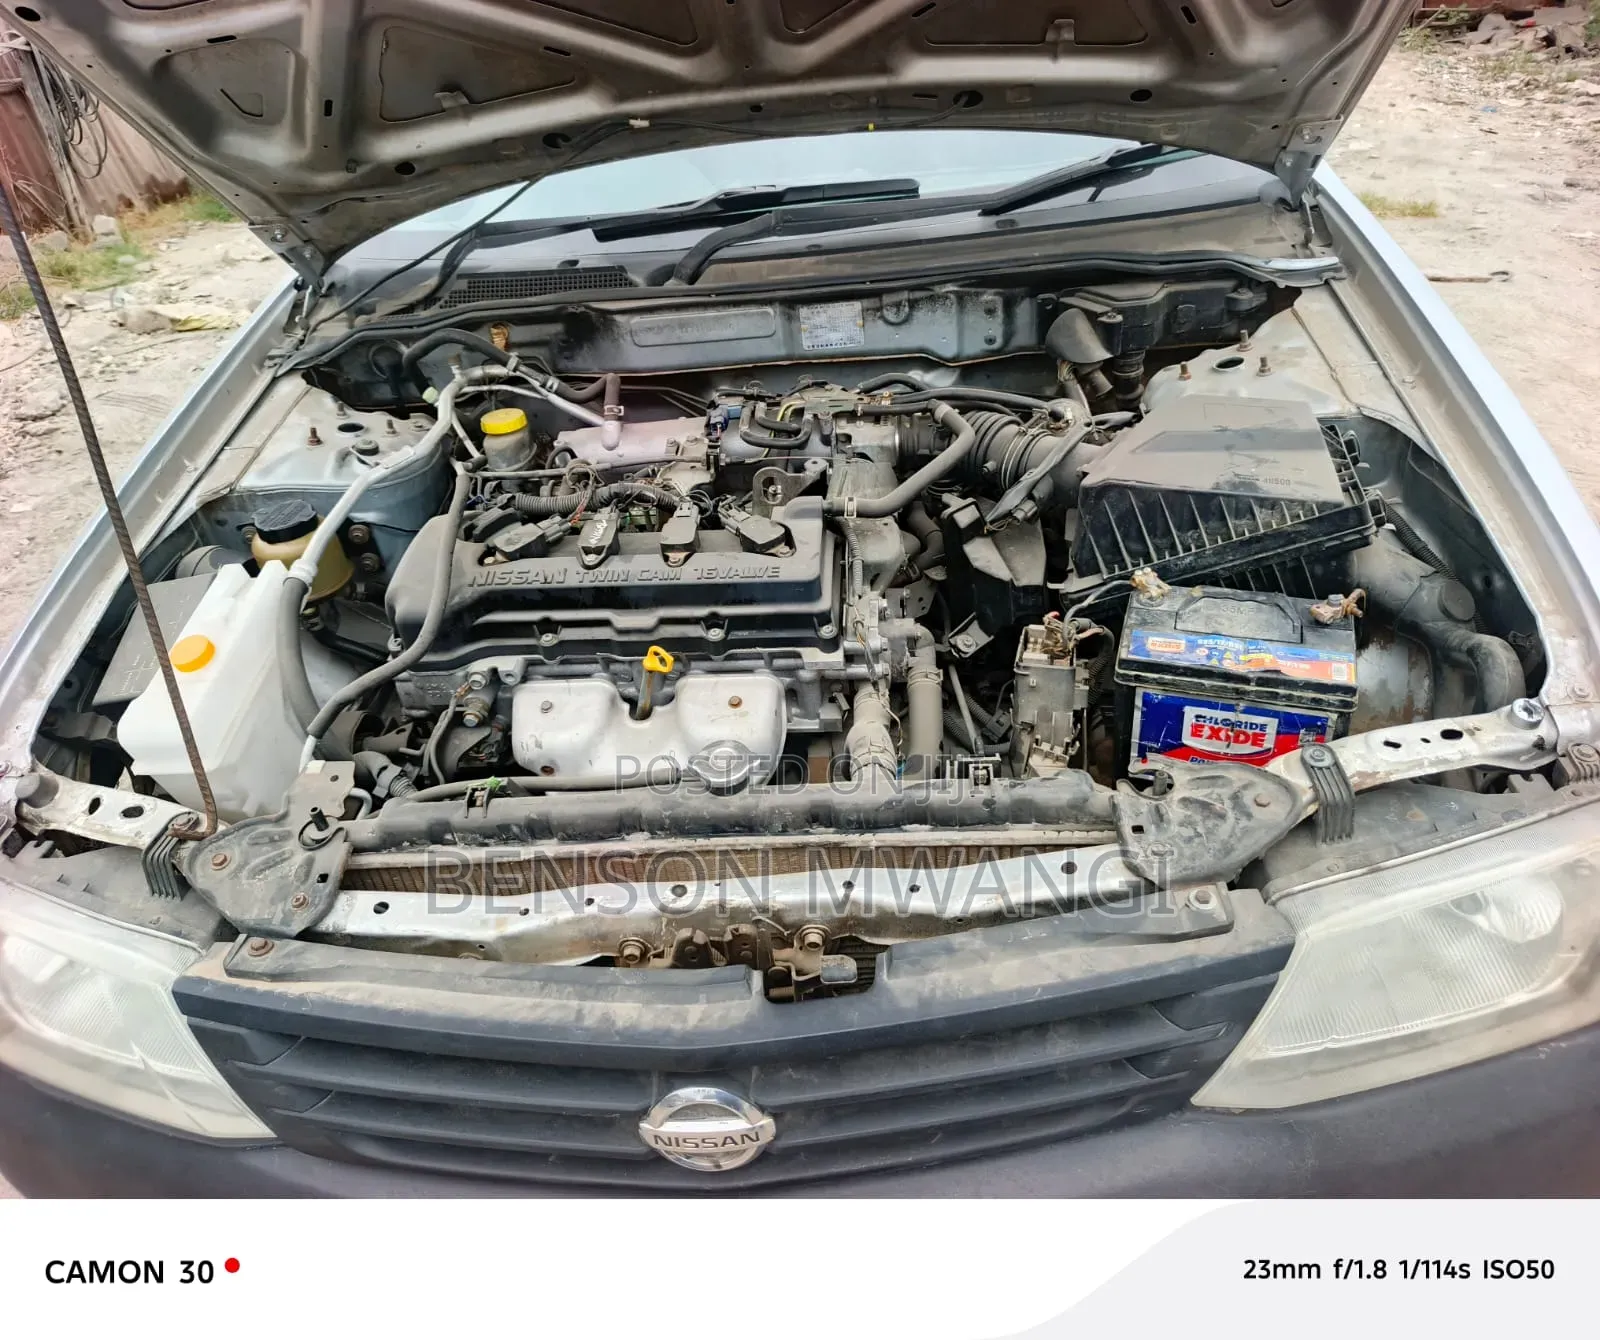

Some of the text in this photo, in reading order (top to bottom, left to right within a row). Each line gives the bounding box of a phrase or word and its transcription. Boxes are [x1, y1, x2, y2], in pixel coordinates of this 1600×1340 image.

[468, 567, 568, 587] NISSAN
[575, 569, 630, 584] TWIN
[637, 567, 683, 581] CAM
[1193, 714, 1269, 733] CHLORIDE
[1190, 722, 1268, 748] EXIDE
[653, 1131, 760, 1149] NISSAN
